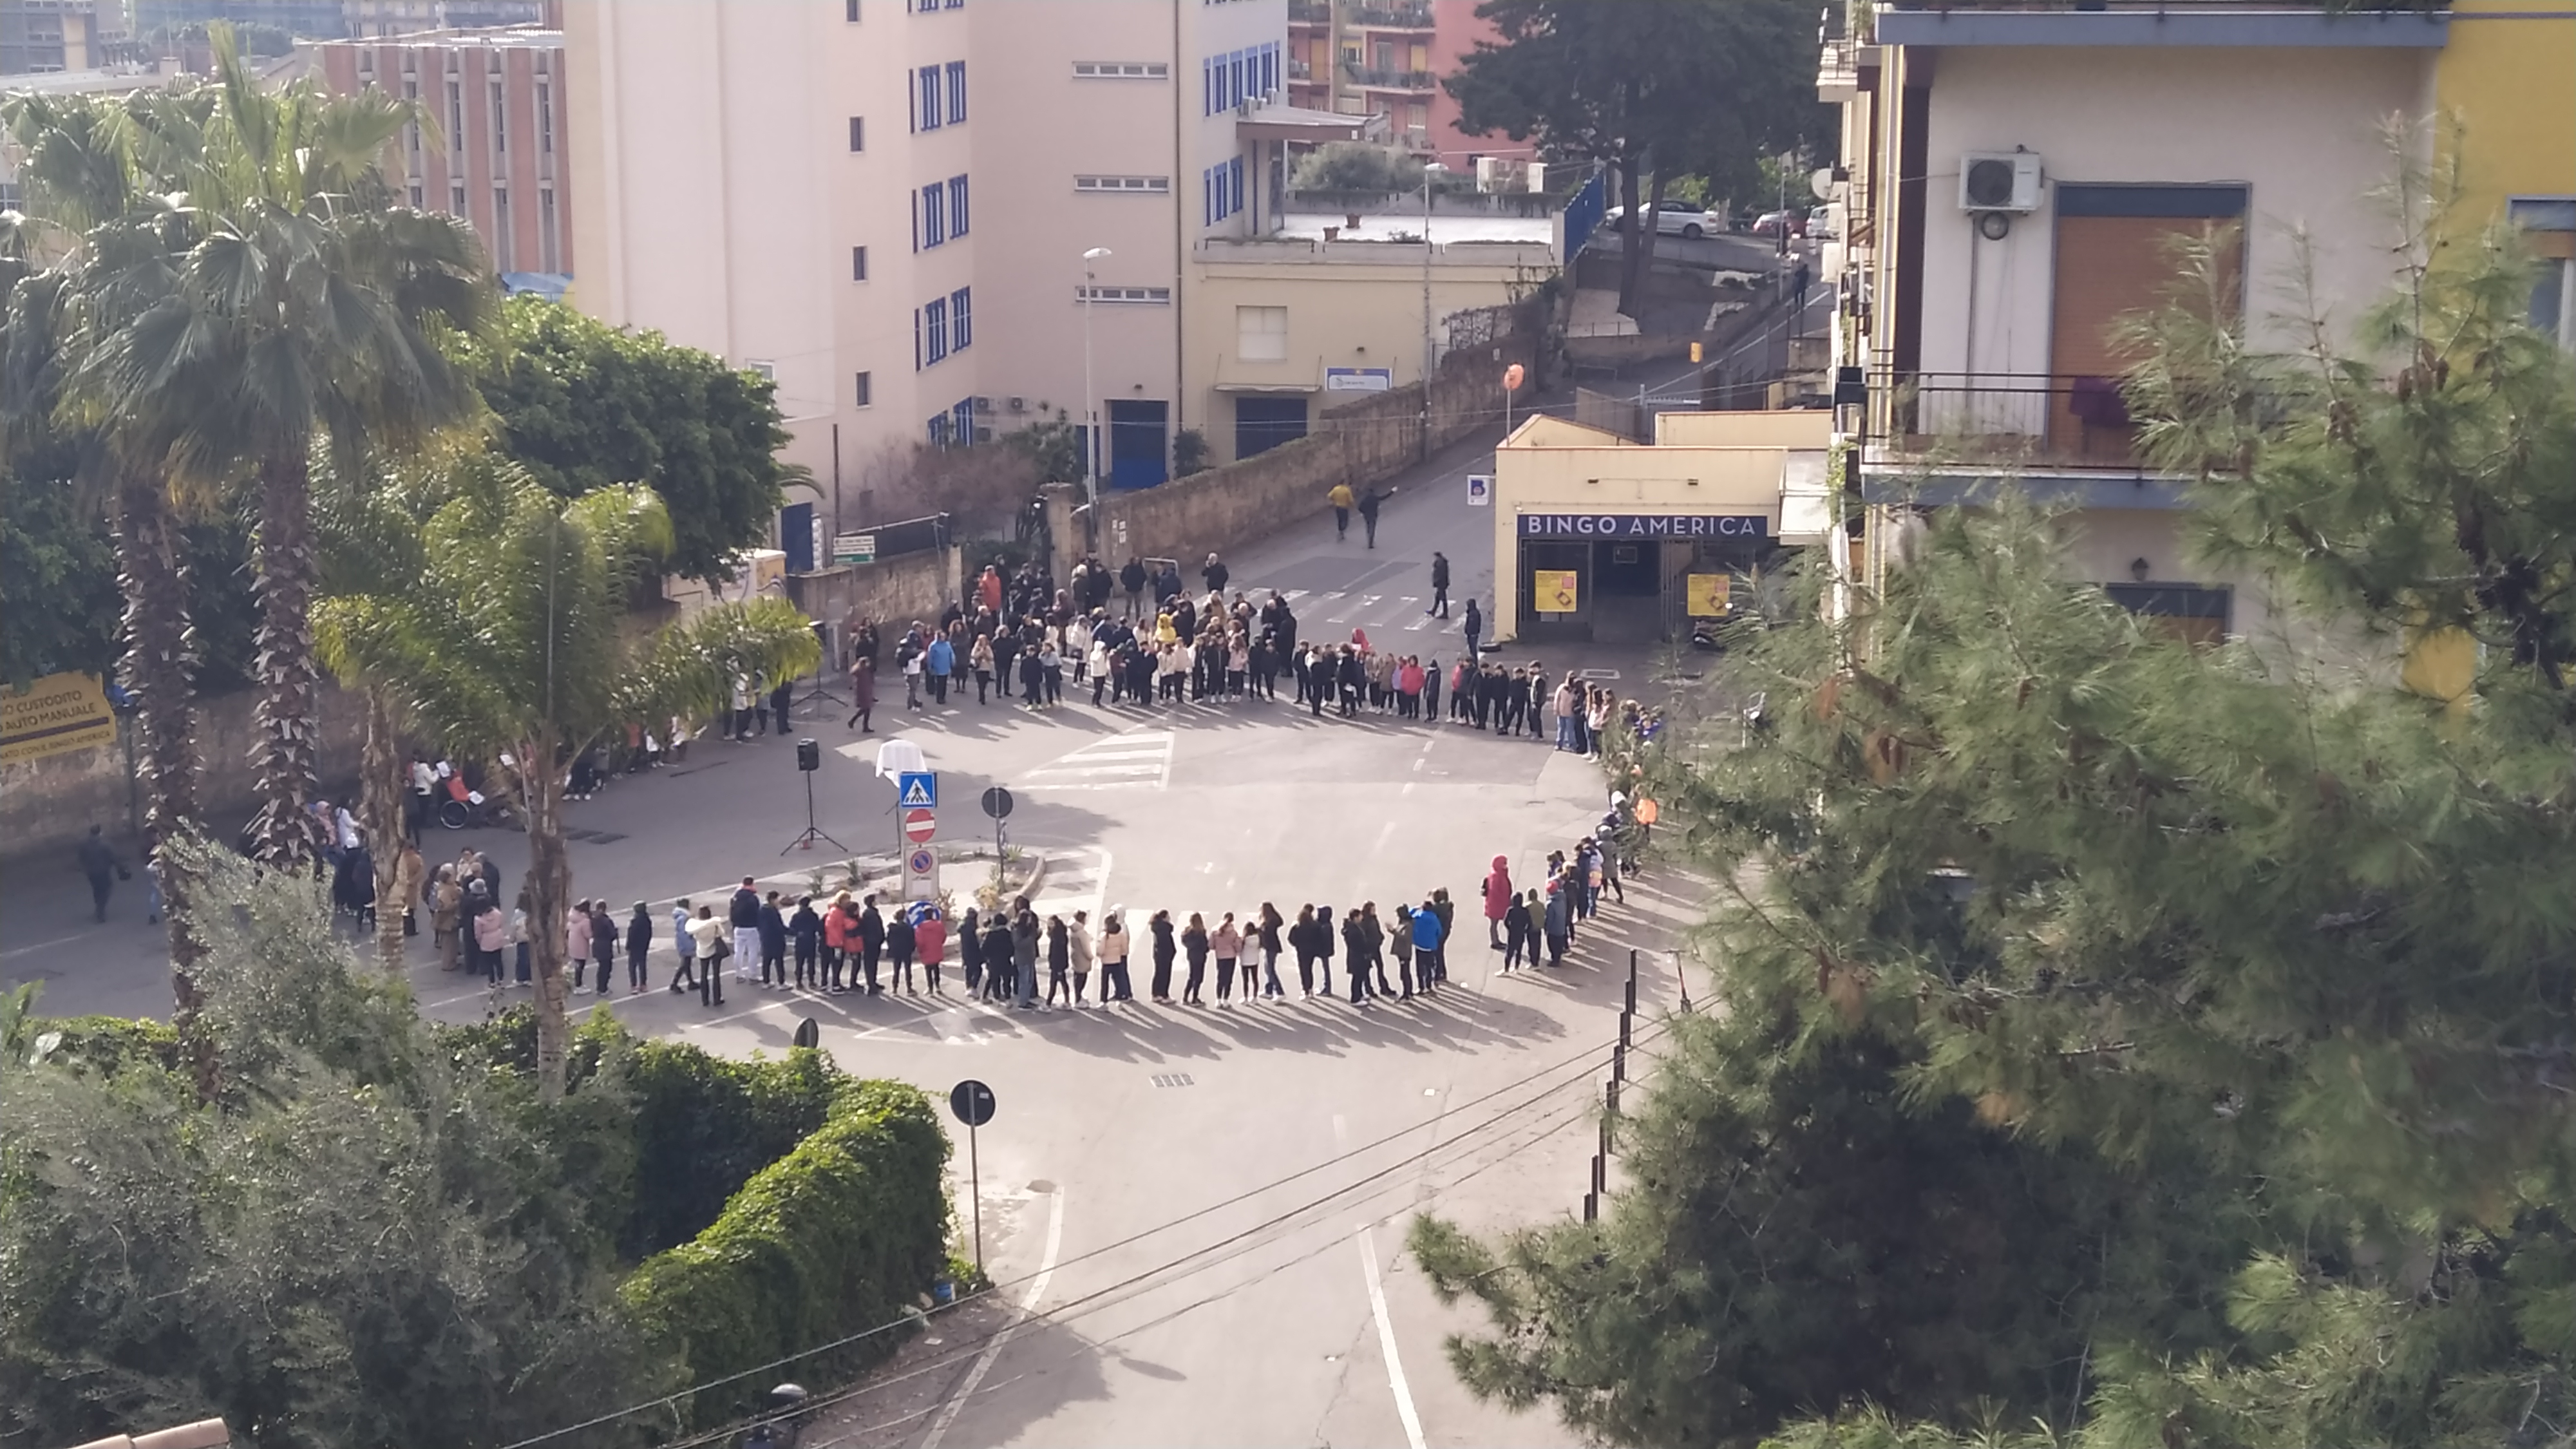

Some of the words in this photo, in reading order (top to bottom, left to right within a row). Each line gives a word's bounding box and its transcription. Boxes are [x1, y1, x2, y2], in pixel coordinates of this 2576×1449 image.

[1528, 516, 1616, 534] BINGO
[1629, 516, 1756, 535] AMERICA
[16, 690, 82, 713] CUSTODITO
[6, 715, 38, 730] AUTO
[39, 702, 97, 723] MANUALE
